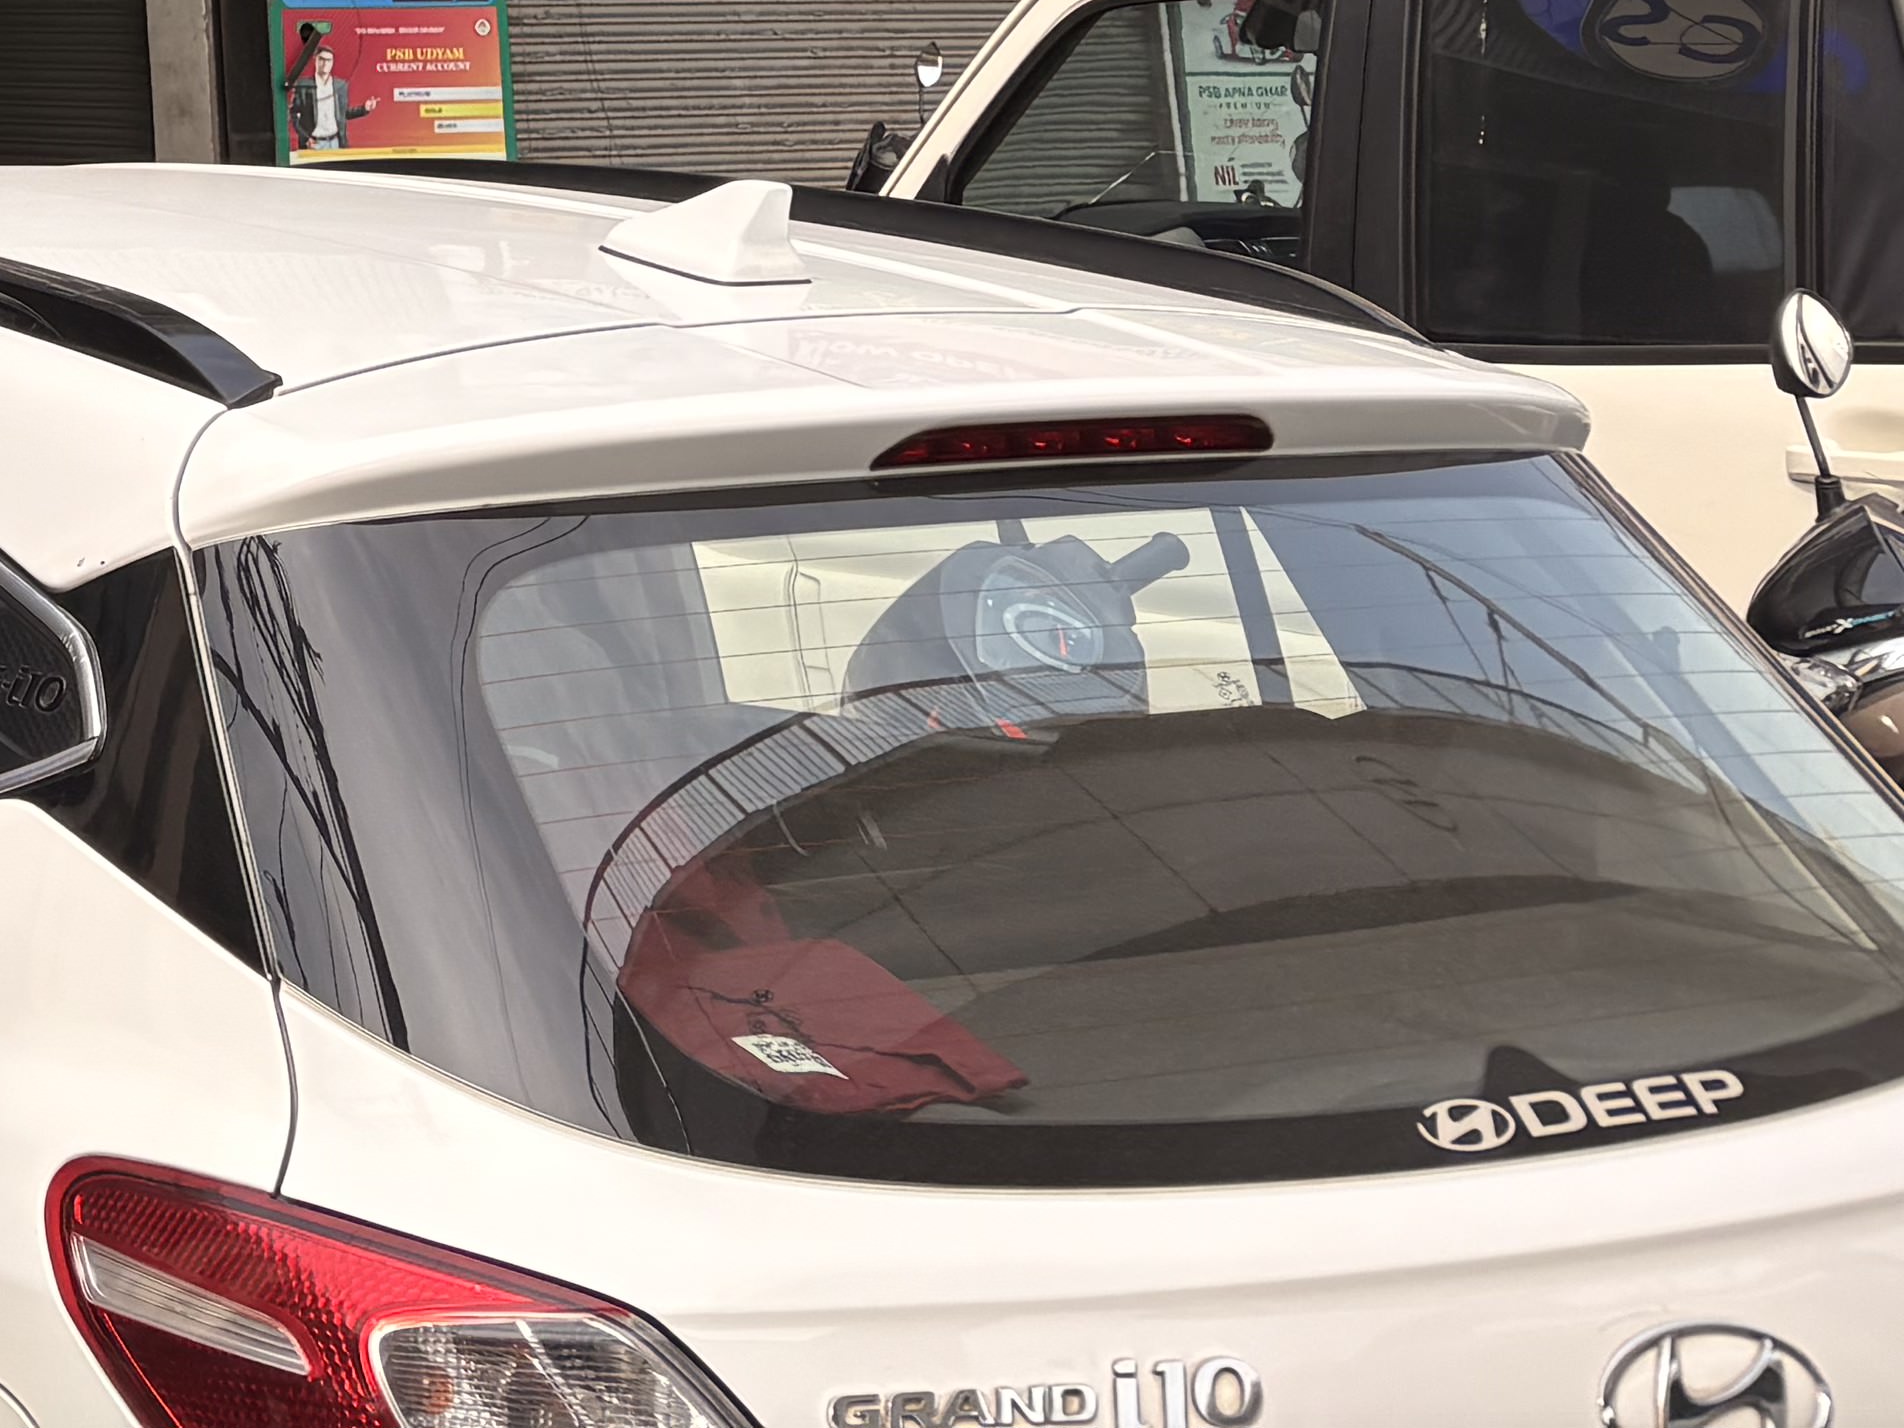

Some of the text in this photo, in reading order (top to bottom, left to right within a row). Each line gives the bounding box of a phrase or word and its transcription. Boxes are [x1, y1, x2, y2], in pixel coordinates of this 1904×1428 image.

[1511, 1070, 1745, 1141] DEEP
[826, 1356, 1265, 1428] GRAND i10
